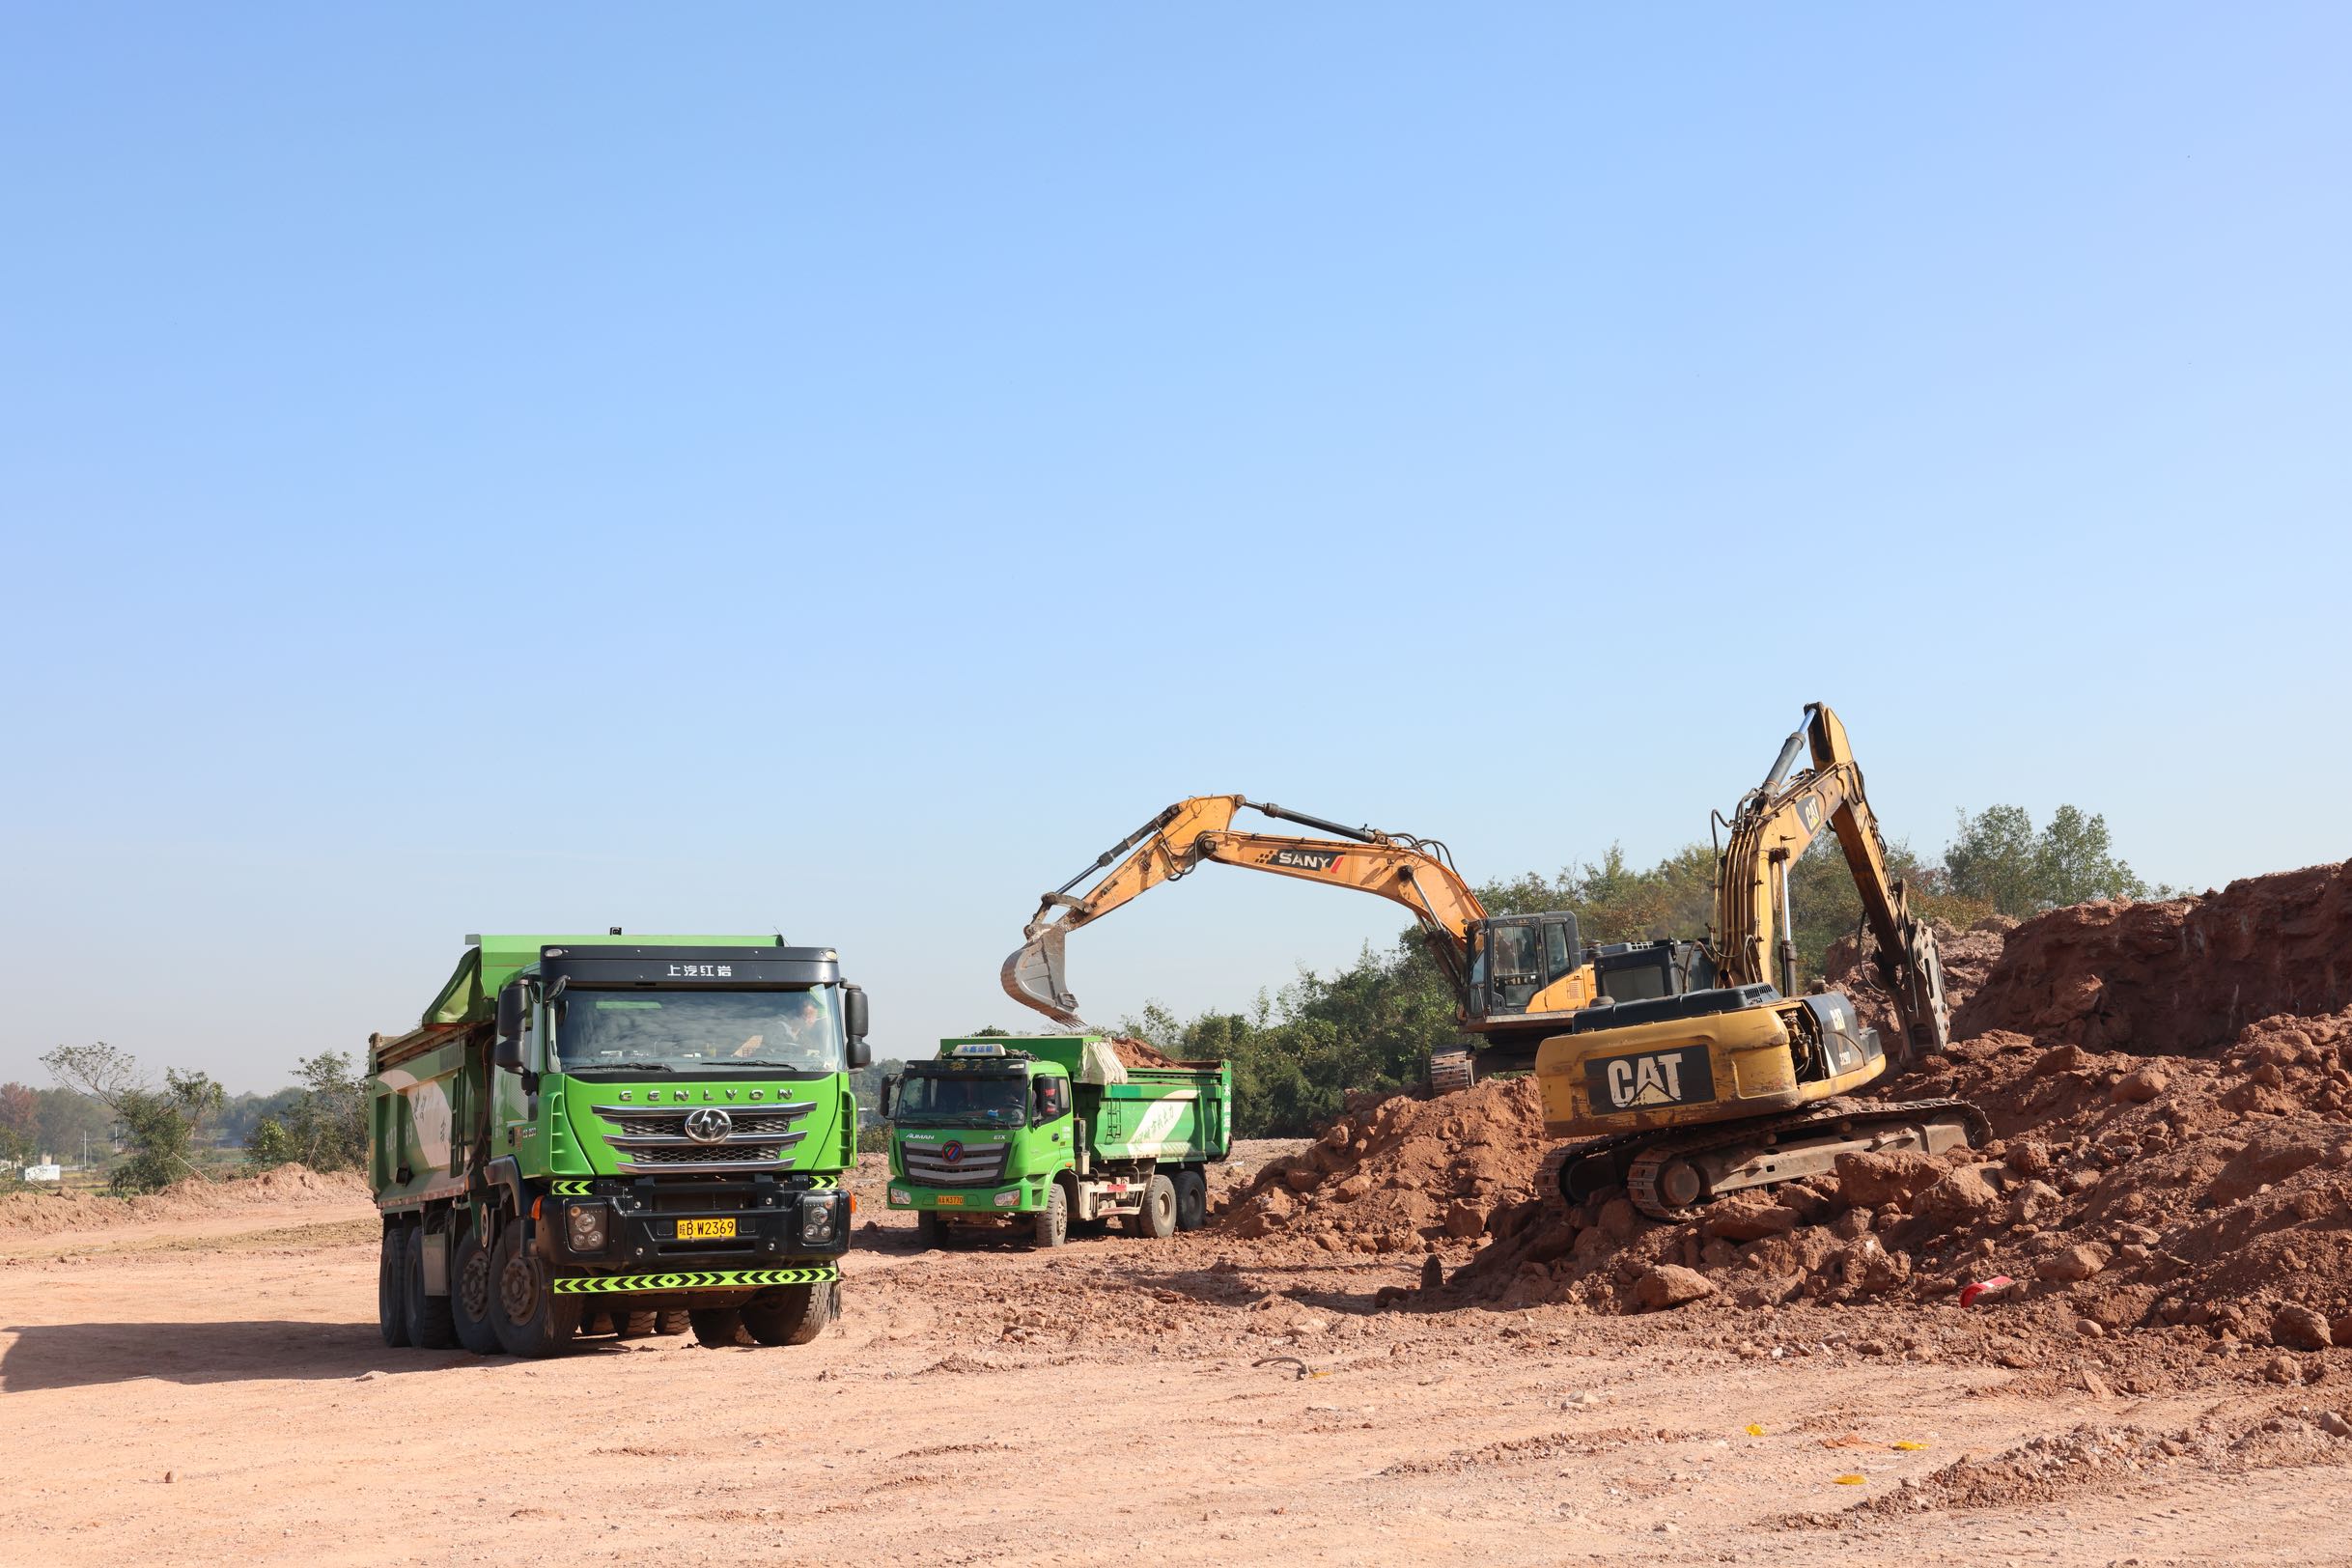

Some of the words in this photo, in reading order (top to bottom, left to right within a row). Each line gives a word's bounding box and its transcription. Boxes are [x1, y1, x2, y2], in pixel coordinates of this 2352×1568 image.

[1806, 798, 1820, 830] CAT
[1278, 853, 1330, 867] SANY
[667, 965, 732, 977] 上汽红岩
[1608, 1053, 1682, 1107] CAT
[618, 1088, 793, 1103] GENLYON
